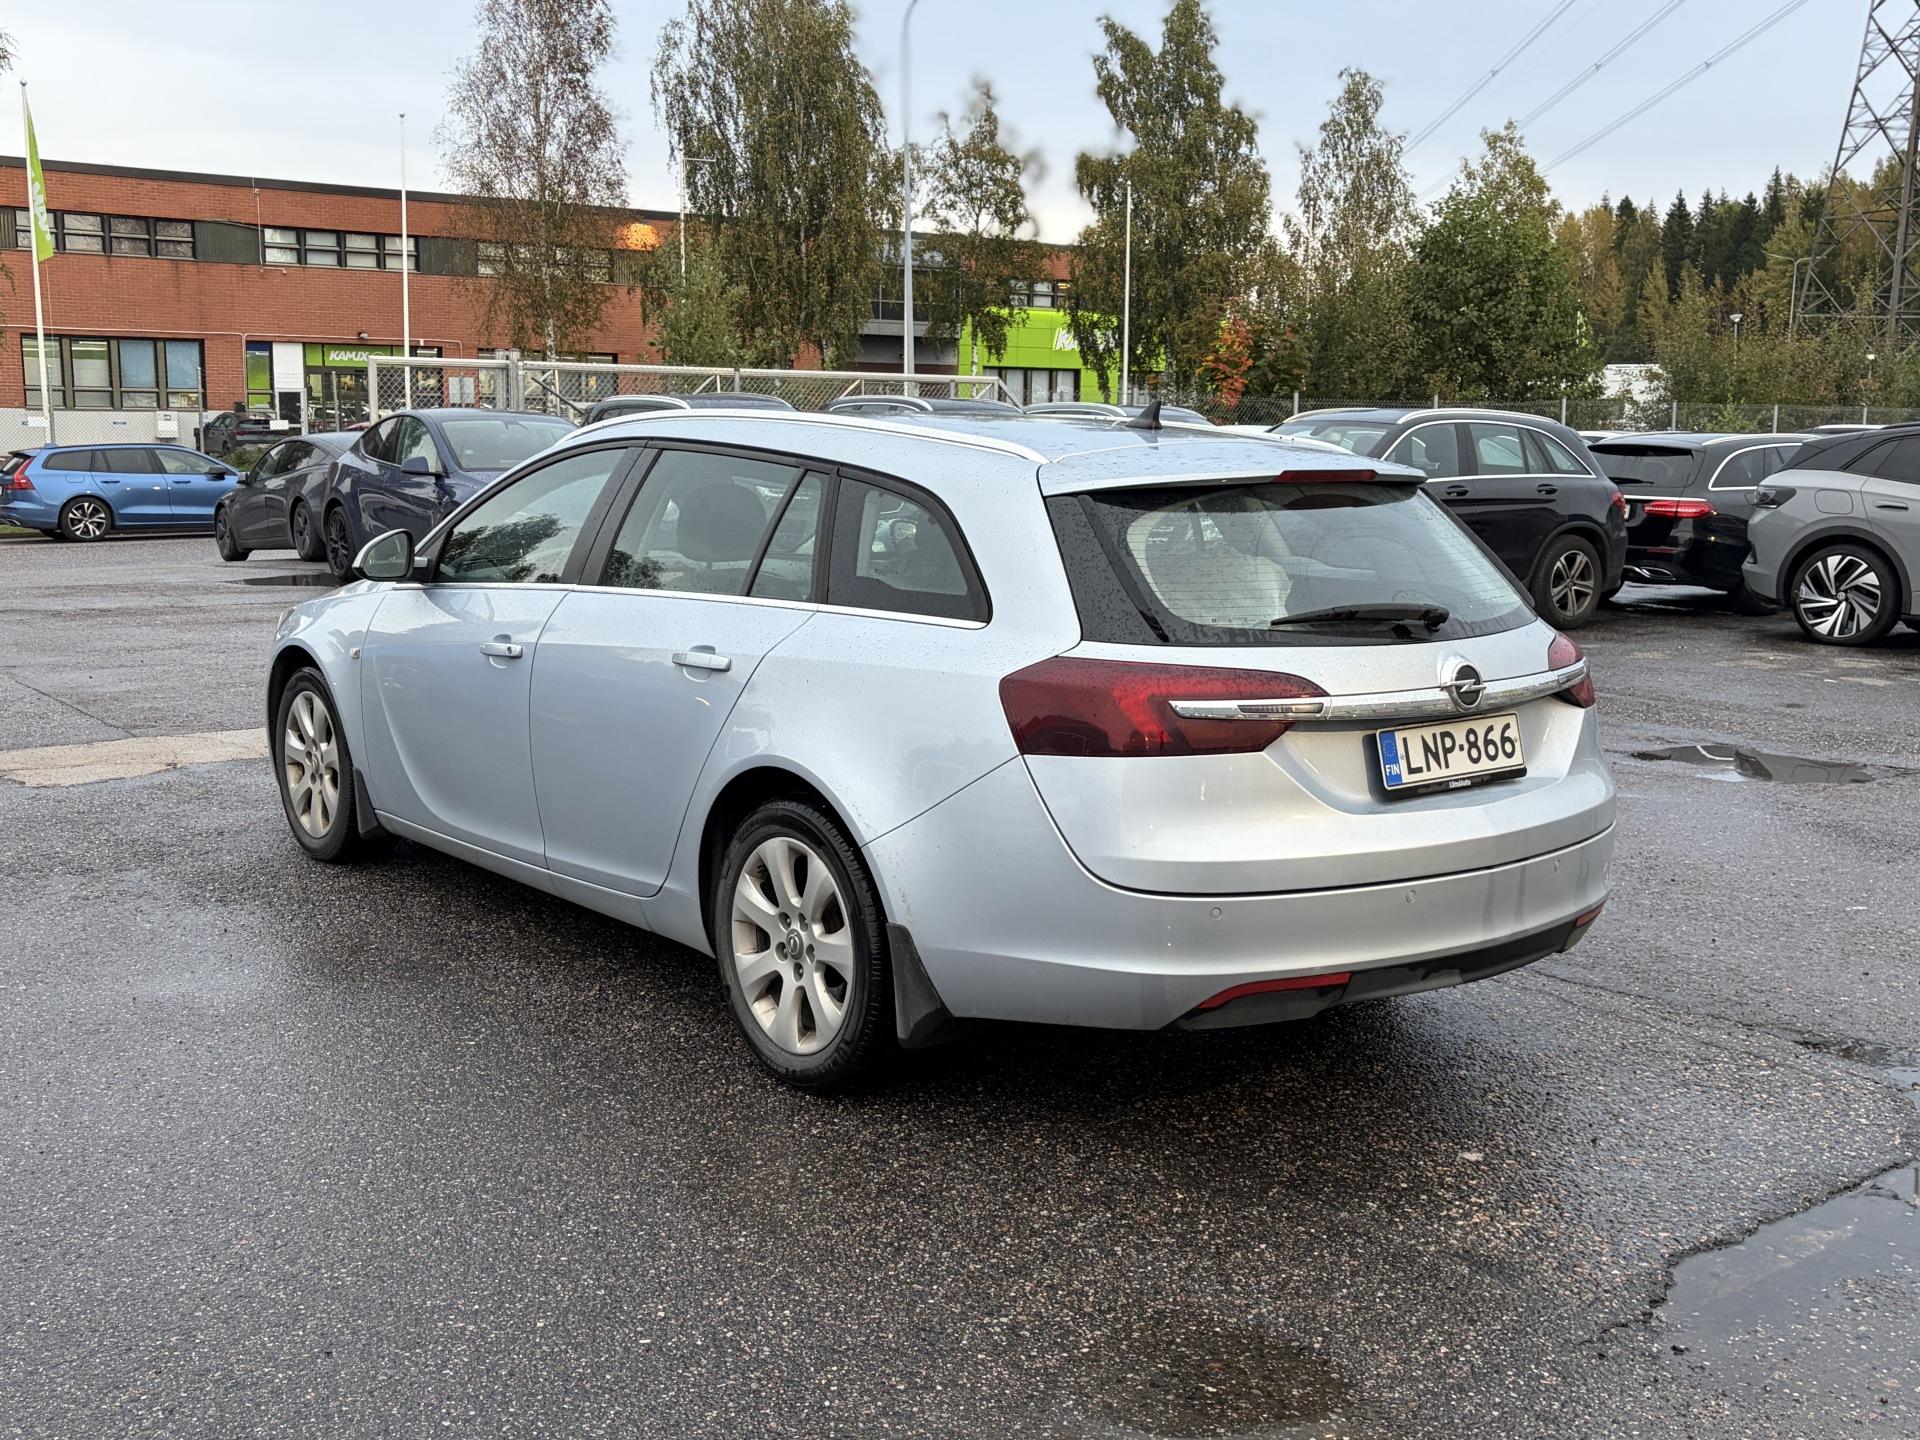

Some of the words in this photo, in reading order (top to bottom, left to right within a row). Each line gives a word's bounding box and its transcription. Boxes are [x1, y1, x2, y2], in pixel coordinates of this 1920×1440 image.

[330, 350, 369, 361] KAMUX
[1402, 722, 1516, 775] LNP-866
[1385, 763, 1400, 776] FIN
